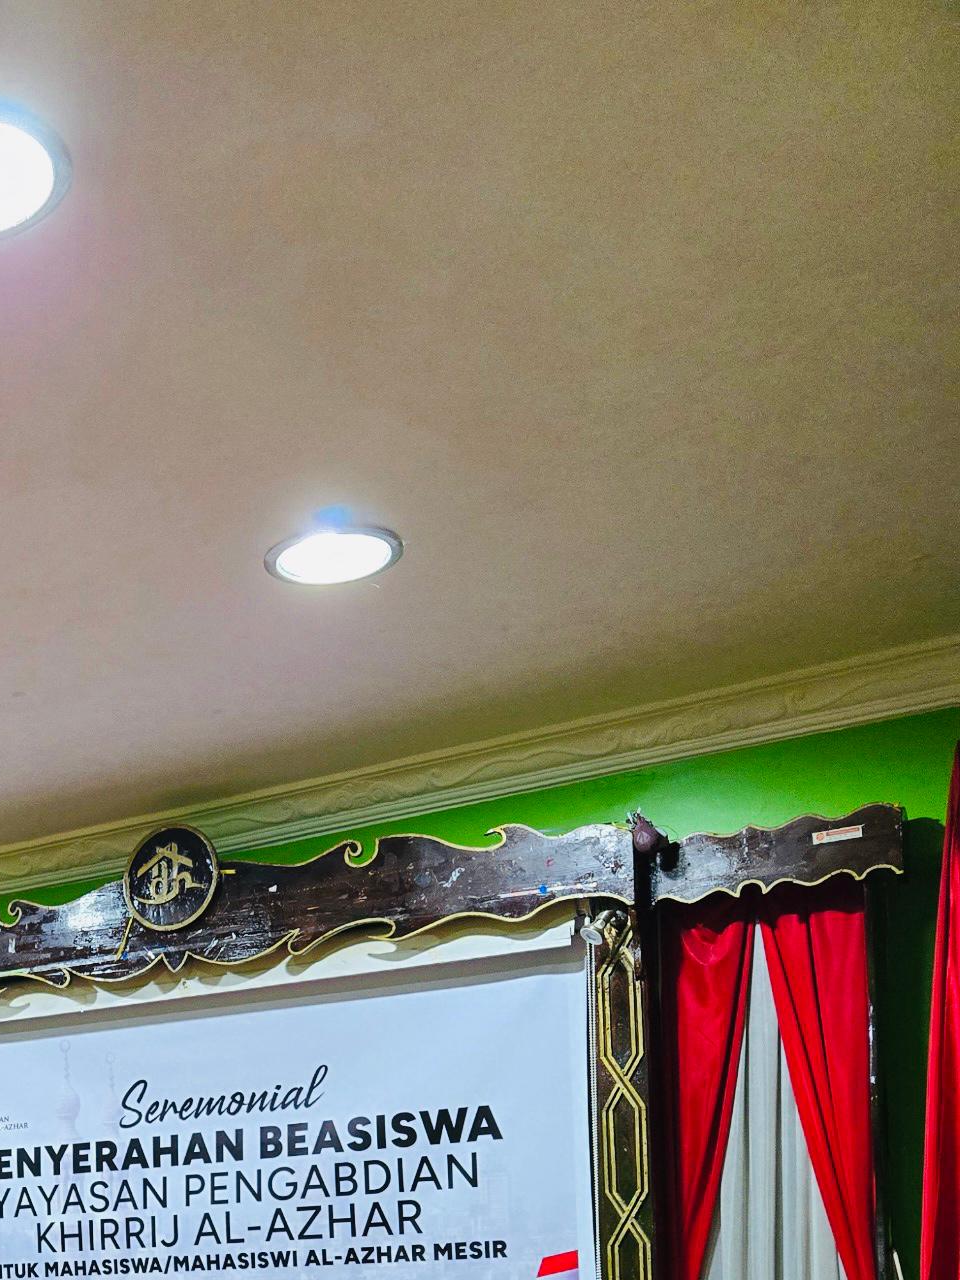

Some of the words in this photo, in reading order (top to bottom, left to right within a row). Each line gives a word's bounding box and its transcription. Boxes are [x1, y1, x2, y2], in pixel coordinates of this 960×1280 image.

[119, 1064, 329, 1130] Seremonial
[259, 1105, 504, 1160] BEASISWA
[185, 1151, 479, 1207] PENGABDIAN
[37, 1214, 179, 1254] KHIRRIJ
[194, 1200, 424, 1246] AL-AZHAR
[44, 1249, 298, 1278] MAHASISWA/MAHASISWI
[304, 1244, 426, 1267] AL-AZHAR
[433, 1239, 508, 1261] MESIR
